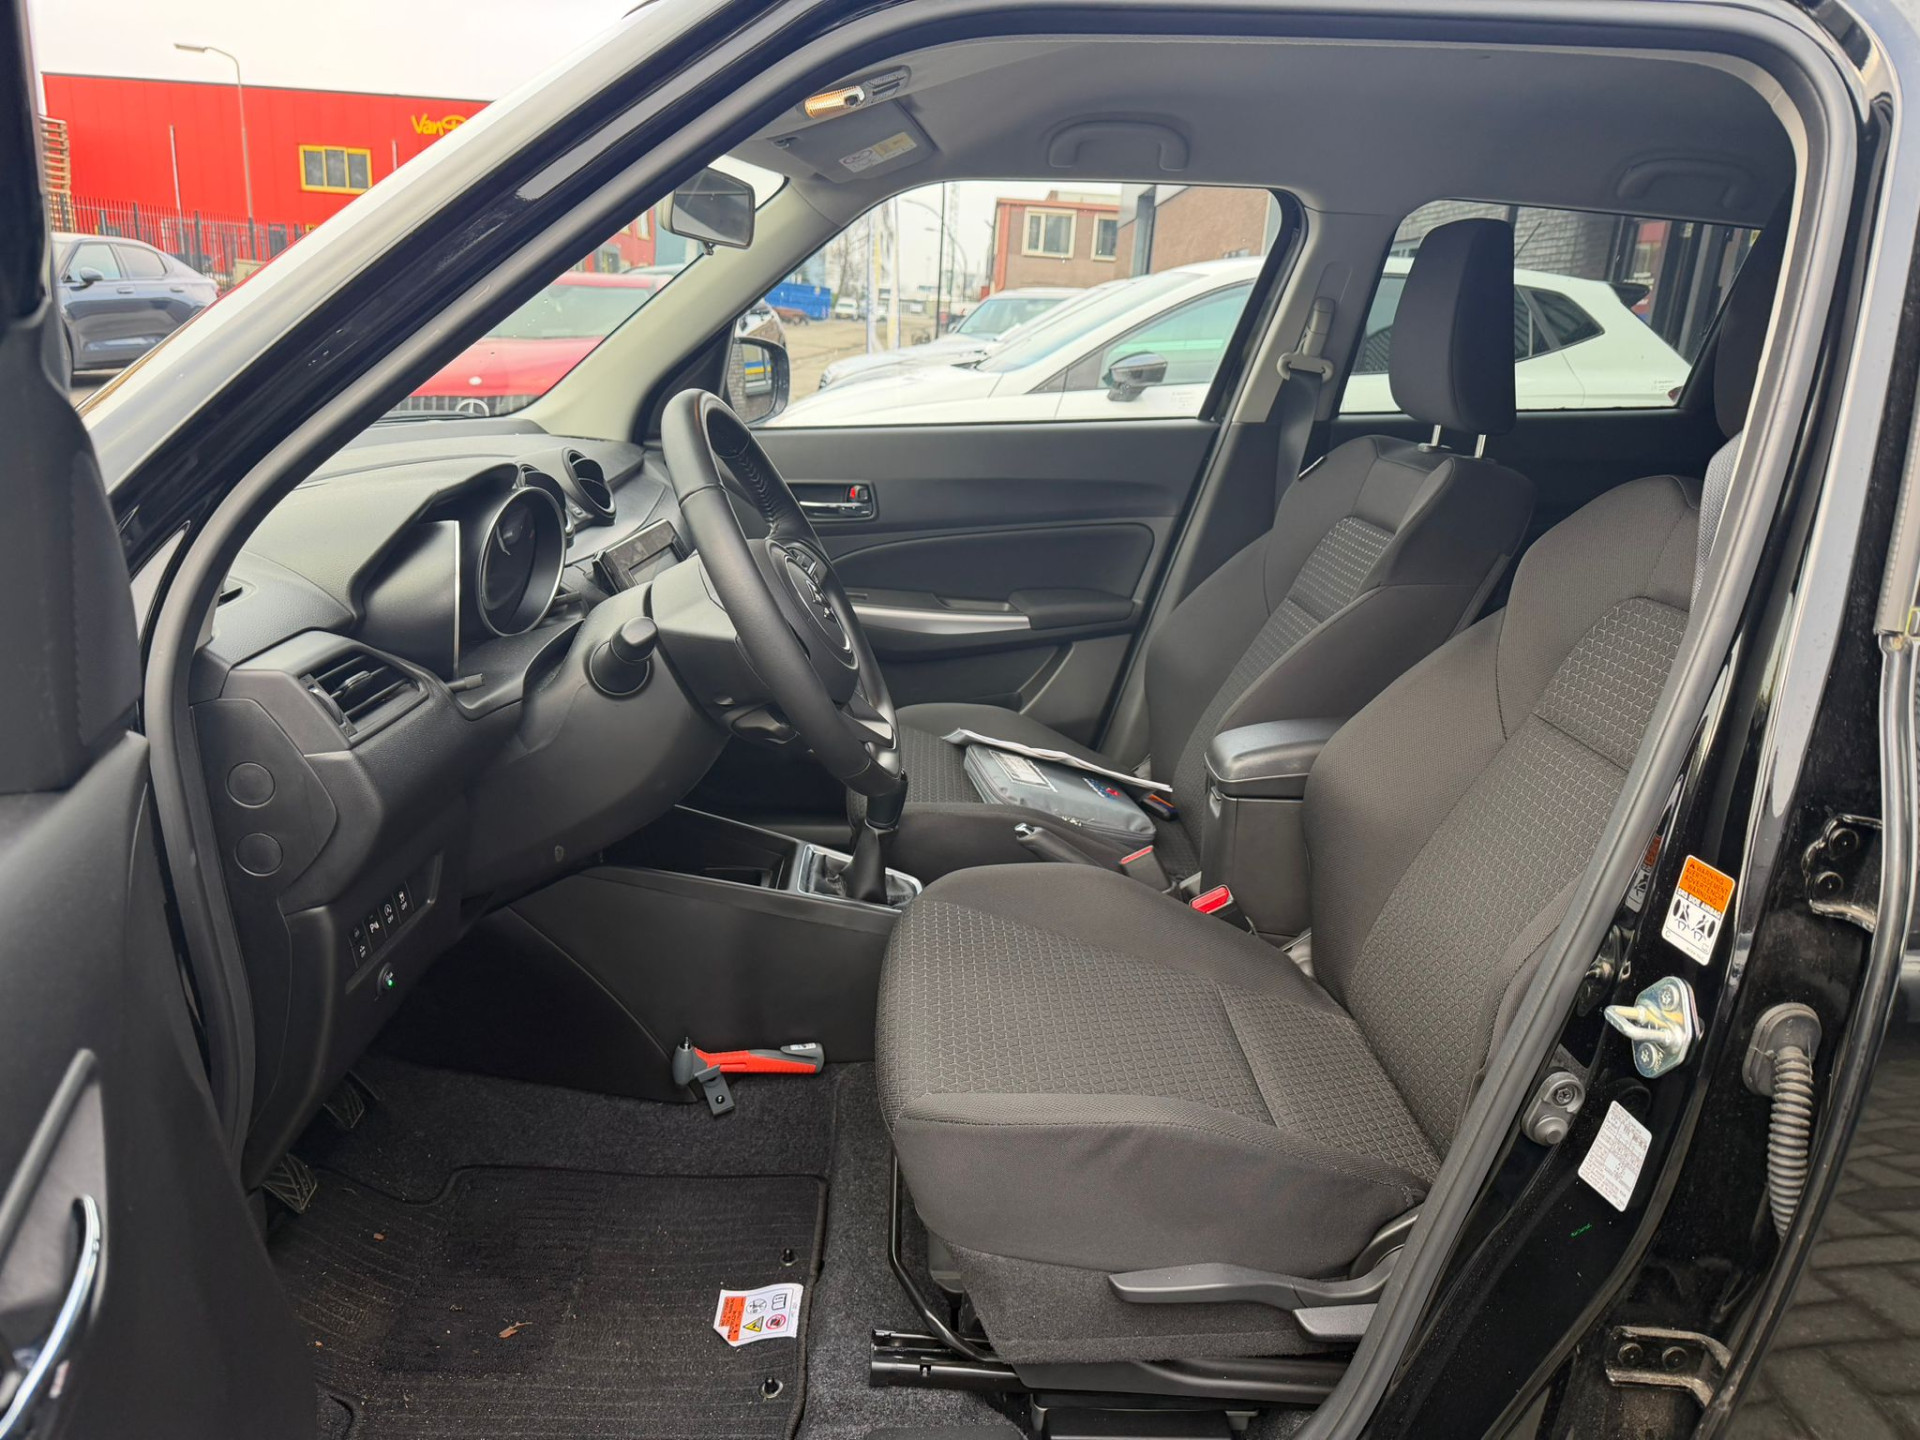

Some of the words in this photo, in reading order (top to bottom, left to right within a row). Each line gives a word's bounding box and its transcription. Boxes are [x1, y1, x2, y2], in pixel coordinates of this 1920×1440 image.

[1685, 867, 1729, 895] AVERTISSEMENT
[1696, 866, 1725, 886] WARNING
[1687, 884, 1717, 906] WARNUNG
